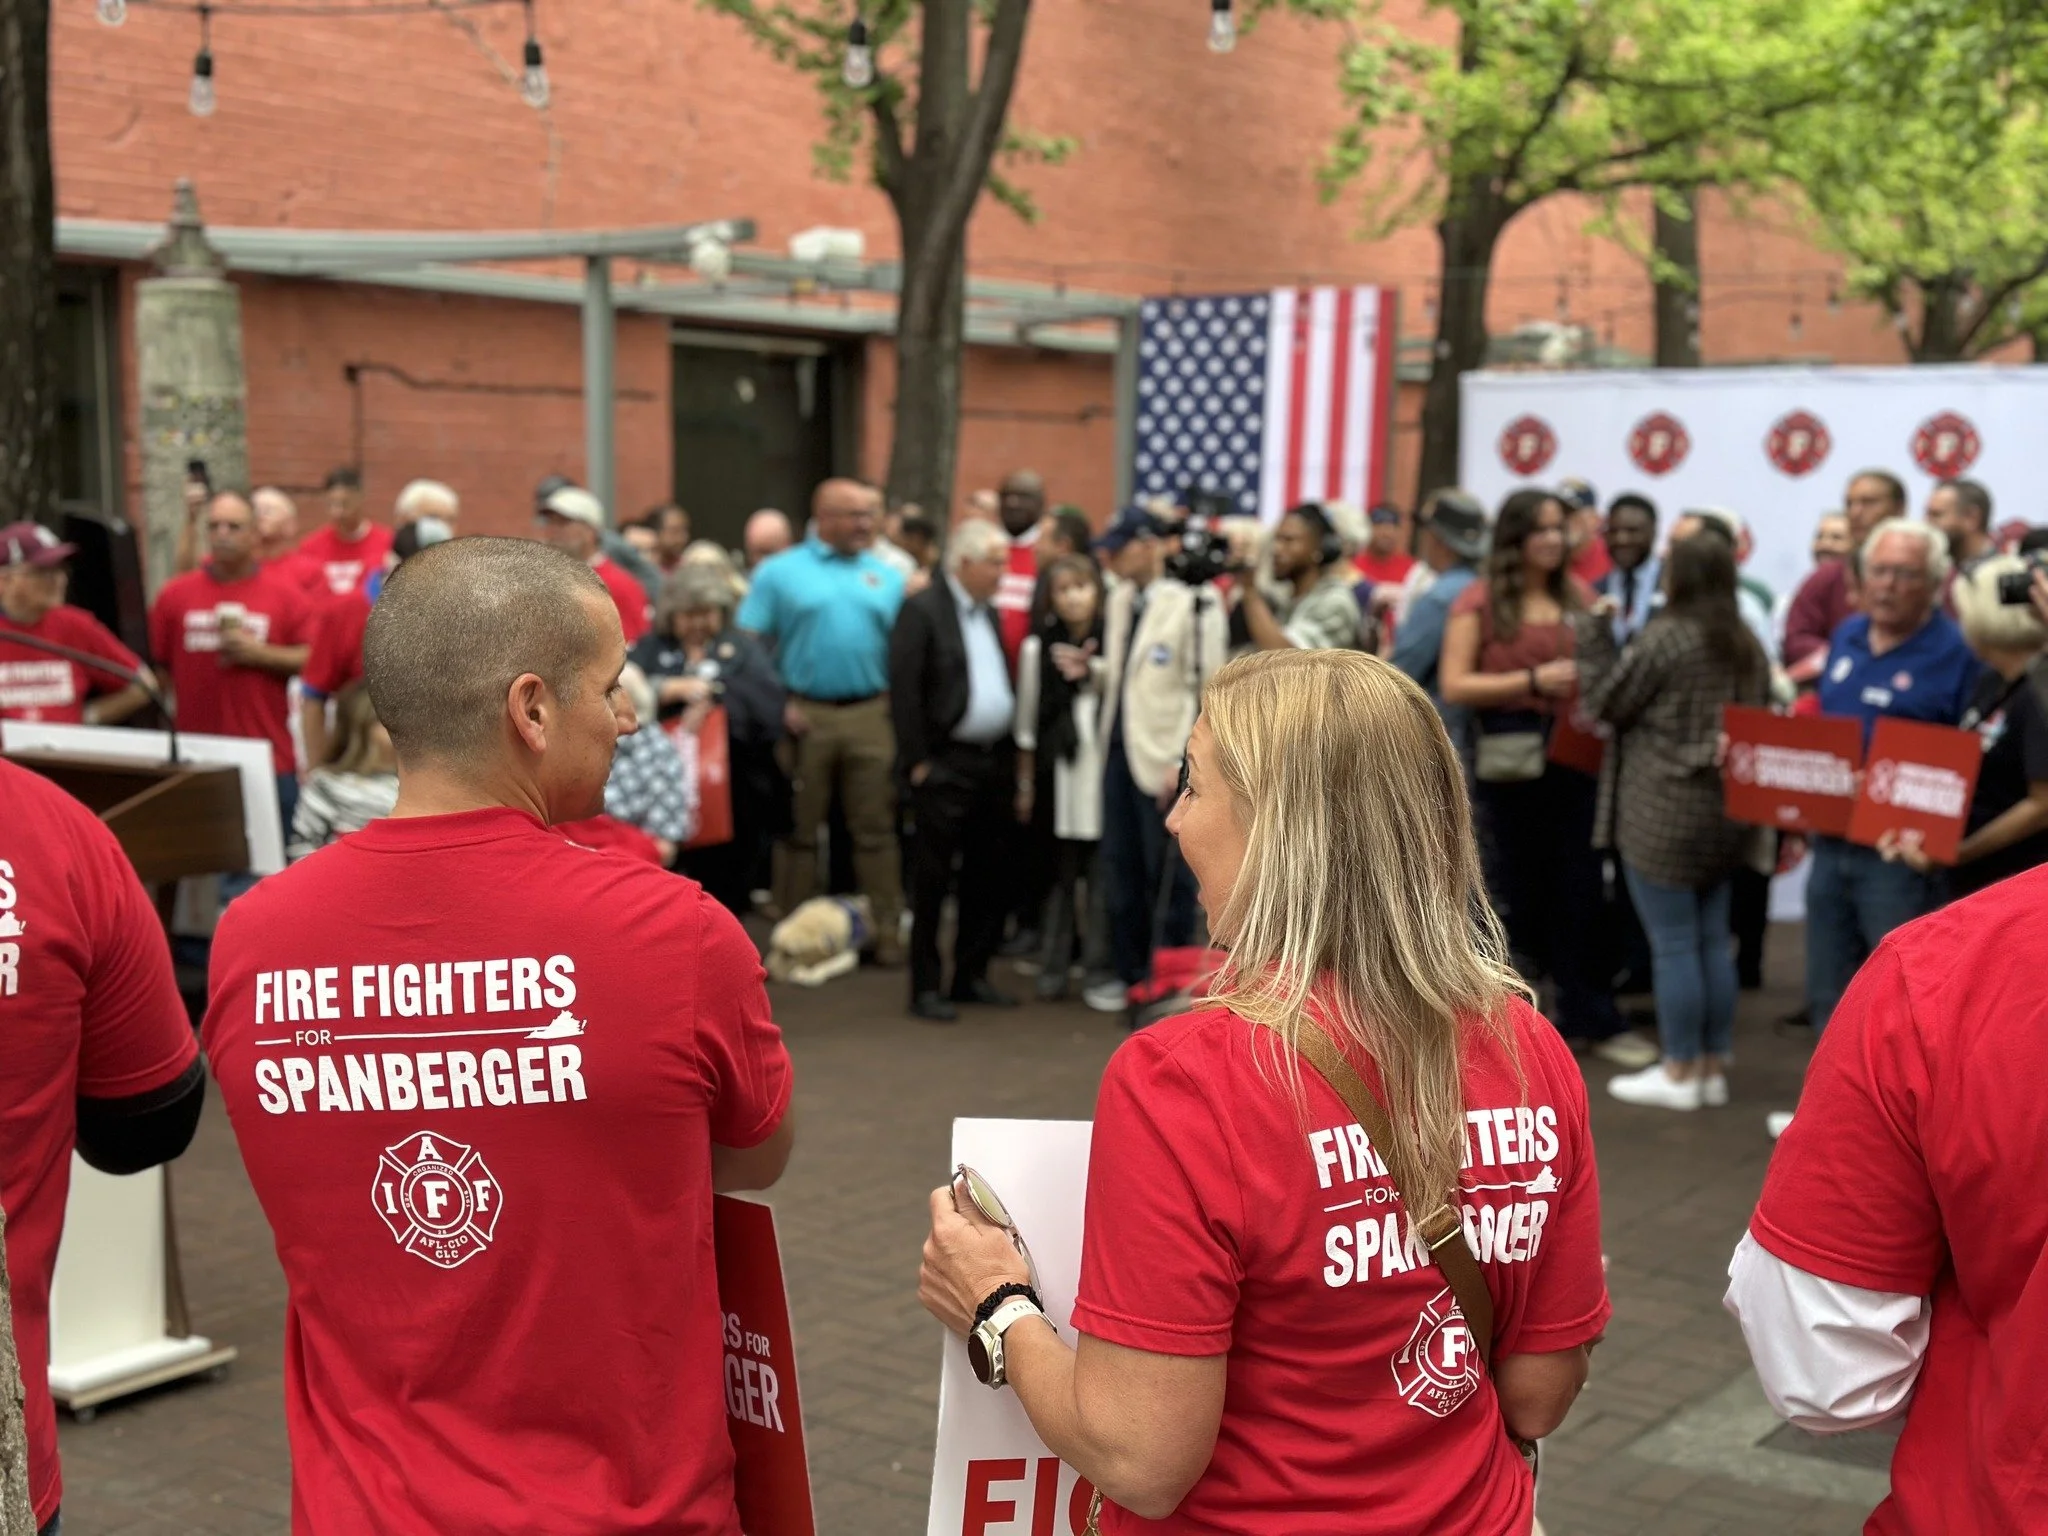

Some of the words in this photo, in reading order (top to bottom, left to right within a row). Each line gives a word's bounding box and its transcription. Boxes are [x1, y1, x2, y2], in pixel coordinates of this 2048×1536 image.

[255, 967, 341, 1024] FIRE
[352, 954, 577, 1018] FIGHTERS
[295, 1029, 332, 1047] FOR
[255, 1044, 587, 1115] SPANBERGER
[1308, 1123, 1389, 1189] FIR
[422, 1181, 450, 1218] F
[1365, 1185, 1398, 1206] FOR
[420, 1235, 469, 1250] AFL-CIO
[435, 1249, 459, 1259] CLC
[745, 1331, 771, 1358] FOR
[1441, 1326, 1466, 1368] F
[724, 1353, 785, 1433] GER
[1427, 1383, 1471, 1401] AFL-CIO
